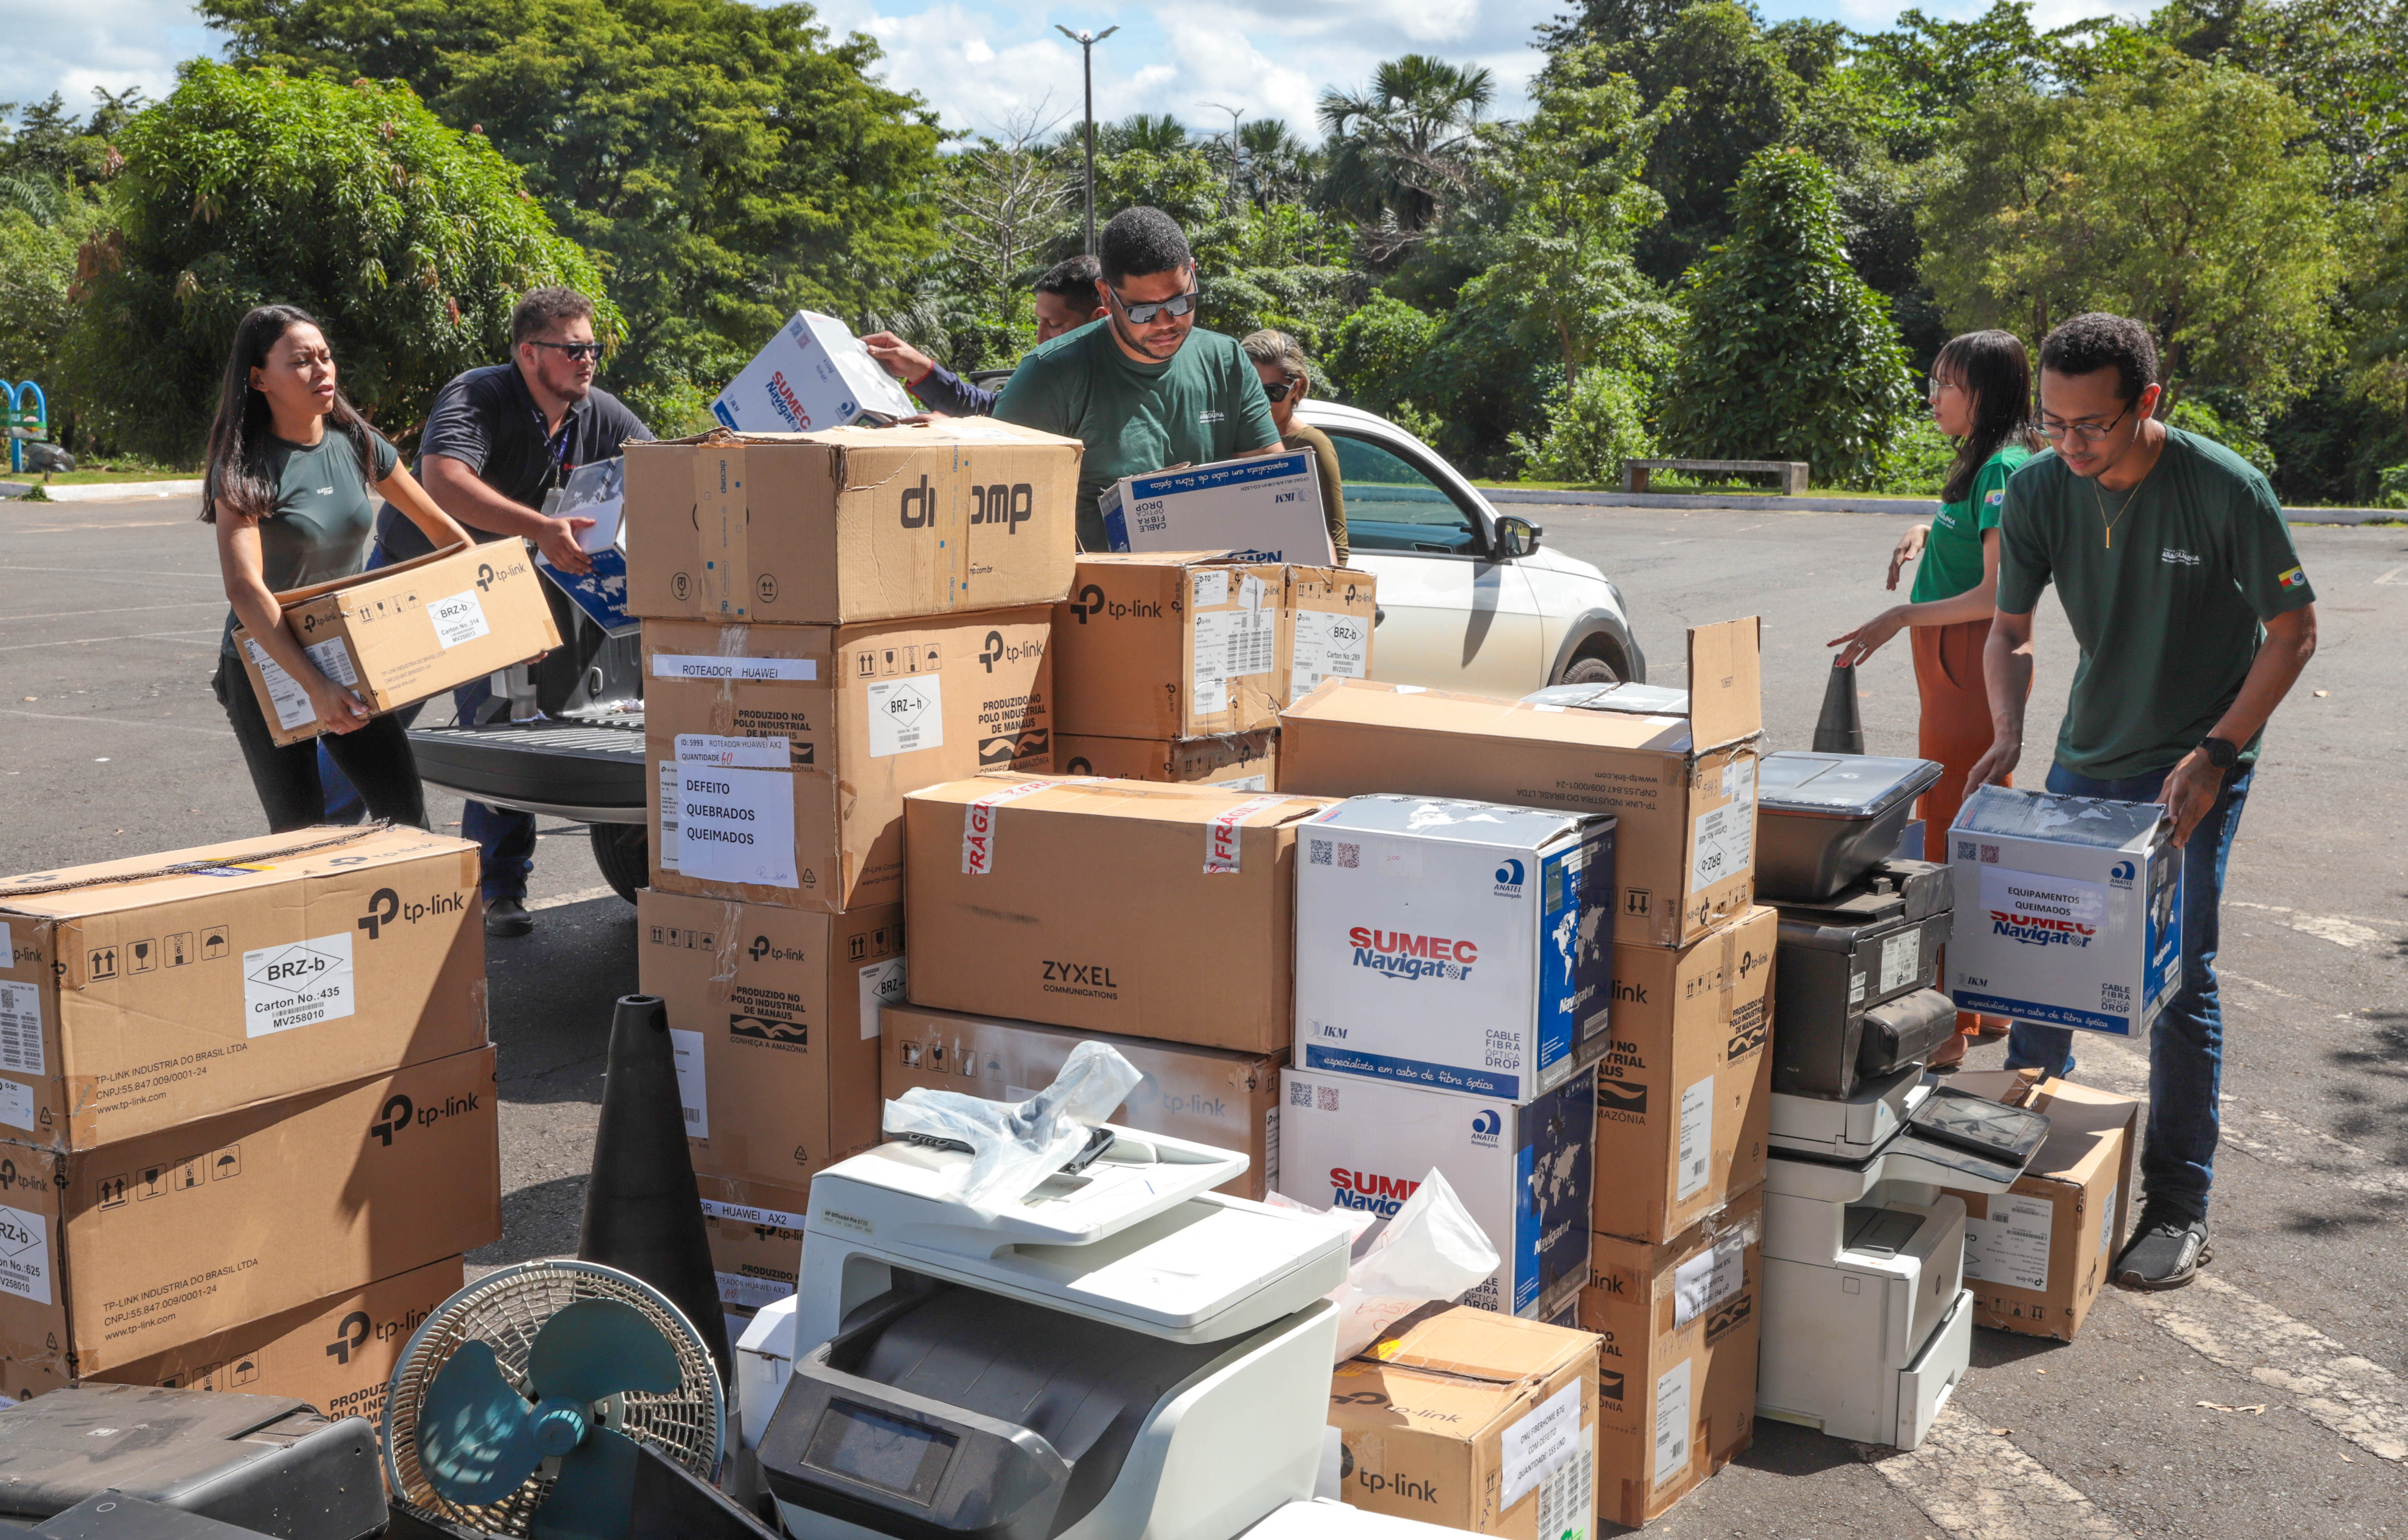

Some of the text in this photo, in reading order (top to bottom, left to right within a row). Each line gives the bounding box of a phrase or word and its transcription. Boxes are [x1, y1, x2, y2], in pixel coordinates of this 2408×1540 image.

[772, 371, 811, 430] SUMEC
[1247, 462, 1288, 475] especialista
[1150, 480, 1171, 490] óptica
[1175, 477, 1194, 487] fibra
[1198, 475, 1209, 484] de
[1211, 472, 1229, 482] cabo
[901, 474, 1032, 535] diomp
[1136, 501, 1163, 511] DROP
[1138, 515, 1165, 525] FIBRA
[1140, 522, 1166, 532] CABLE
[496, 563, 526, 581] tp-link
[1356, 593, 1372, 602] tp-link
[440, 604, 467, 618] BRZ-b
[1109, 600, 1162, 620] tp-link
[1334, 627, 1356, 640] BRZ-b
[1006, 640, 1044, 664] tp-link
[683, 665, 778, 678] ROTEADOR HUAWEI
[1720, 676, 1733, 688] 10697
[983, 693, 1041, 712] PRODUZIDO NO
[738, 710, 805, 721] PRODUZIDO NO
[979, 705, 1046, 725] POLO INDUSTRIAL
[733, 719, 811, 731] POLO INDUSTRIAL
[992, 718, 1036, 734] DE MANAUS
[721, 752, 733, 765] 60
[1595, 772, 1658, 783] www.tp-link.com
[686, 780, 730, 794] DEFEITO
[1517, 789, 1537, 798] LTDA
[1556, 781, 1657, 797] CNPJ:55.847.009/0001-24
[1538, 791, 1565, 800] BRASIL
[1581, 795, 1624, 806] INDUSTRIA
[687, 804, 755, 821] QUEBRADOS
[1625, 801, 1656, 810] TP-LINK
[687, 828, 754, 845] QUEIMADOS
[1214, 805, 1261, 860] FRÁGIL
[1565, 850, 1583, 862] ROLDANA
[1702, 852, 1722, 871] BRZ-b
[1494, 884, 1522, 893] ANATEL
[2110, 878, 2133, 886] ANATEL
[1494, 891, 1522, 899] Homologado
[2008, 886, 2079, 904] EQUIPAMENTOS
[404, 891, 465, 924] tp-link
[2015, 900, 2071, 916] QUEIMADOS
[1993, 921, 2091, 947] Navigator
[1349, 927, 1478, 963] SUMEC
[772, 947, 804, 962] tp-link
[1751, 952, 1768, 969] tp-link
[267, 955, 326, 983] BRZ-b
[1353, 947, 1472, 981] Navigator
[1042, 960, 1117, 988] ZYXEL
[736, 986, 800, 1003] PRODUZIDO NO
[1043, 984, 1118, 1000] COMMUNICATIONS
[2102, 983, 2130, 993] CABLE
[2102, 990, 2130, 1000] FIBRA
[254, 985, 340, 1015] Carton No.:435
[731, 995, 806, 1013] POLO INDUSTRIAL
[1733, 996, 1764, 1018] PRODUZIDO NO
[2101, 997, 2130, 1007] ÓPTICA
[2101, 1002, 2130, 1013] DROP
[273, 1008, 325, 1030] MV258010
[744, 1006, 792, 1020] DE MANAUS
[1729, 1004, 1766, 1029] POLO INDUSTRIAL
[1967, 999, 2010, 1011] especialista
[2027, 1008, 2045, 1017] cabo
[2048, 1010, 2059, 1020] de
[2062, 1012, 2082, 1024] fibra
[2084, 1017, 2108, 1028] óptica
[1742, 1016, 1760, 1031] MANAUS
[1486, 1029, 1521, 1042] CABLE
[730, 1036, 763, 1048] CONHEÇA
[771, 1042, 807, 1054] AMAZÔNIA
[1486, 1039, 1521, 1052] FIBRA
[1485, 1048, 1520, 1061] ÓPTICA
[95, 1042, 248, 1086] TP-LINK INDUSTRIA DO BRASIL LTDA
[1485, 1057, 1520, 1070] DROP
[1324, 1056, 1495, 1091] especialista em cabo de fibra óptica
[96, 1066, 207, 1101] CNPJ:55.847.009/0001-24
[97, 1089, 167, 1116] www.tp-link.com
[417, 1092, 479, 1128] tp-link
[1162, 1093, 1226, 1117] tp-link
[1471, 1133, 1499, 1143] ANATEL
[1471, 1140, 1499, 1149] Homologado
[18, 1174, 48, 1192] tp-link
[723, 1205, 787, 1225] HUAWEI AX2
[831, 1212, 849, 1221] OfficeJet
[0, 1222, 28, 1244] RZ-b
[10, 1259, 40, 1277] No.:625
[742, 1264, 792, 1280] PRODUZIDO
[1691, 1275, 1701, 1285] ONU
[1701, 1263, 1723, 1280] FIBERHOME
[0, 1277, 30, 1293] V258010
[103, 1258, 258, 1313] TP-LINK INDUSTRIA DO BRASIL LTDA
[104, 1284, 218, 1327] CNPJ:55.847.009/0001-24
[104, 1311, 176, 1342] www.tp-link.com
[1383, 1405, 1464, 1424] tp-link
[1521, 1405, 1564, 1444] ONU FIBERHOME B7G
[1528, 1428, 1556, 1454] COM DEFEITO
[1518, 1452, 1548, 1480] QUANTIDADE:
[1557, 1437, 1565, 1450] UND
[1360, 1466, 1438, 1505] tp-link
